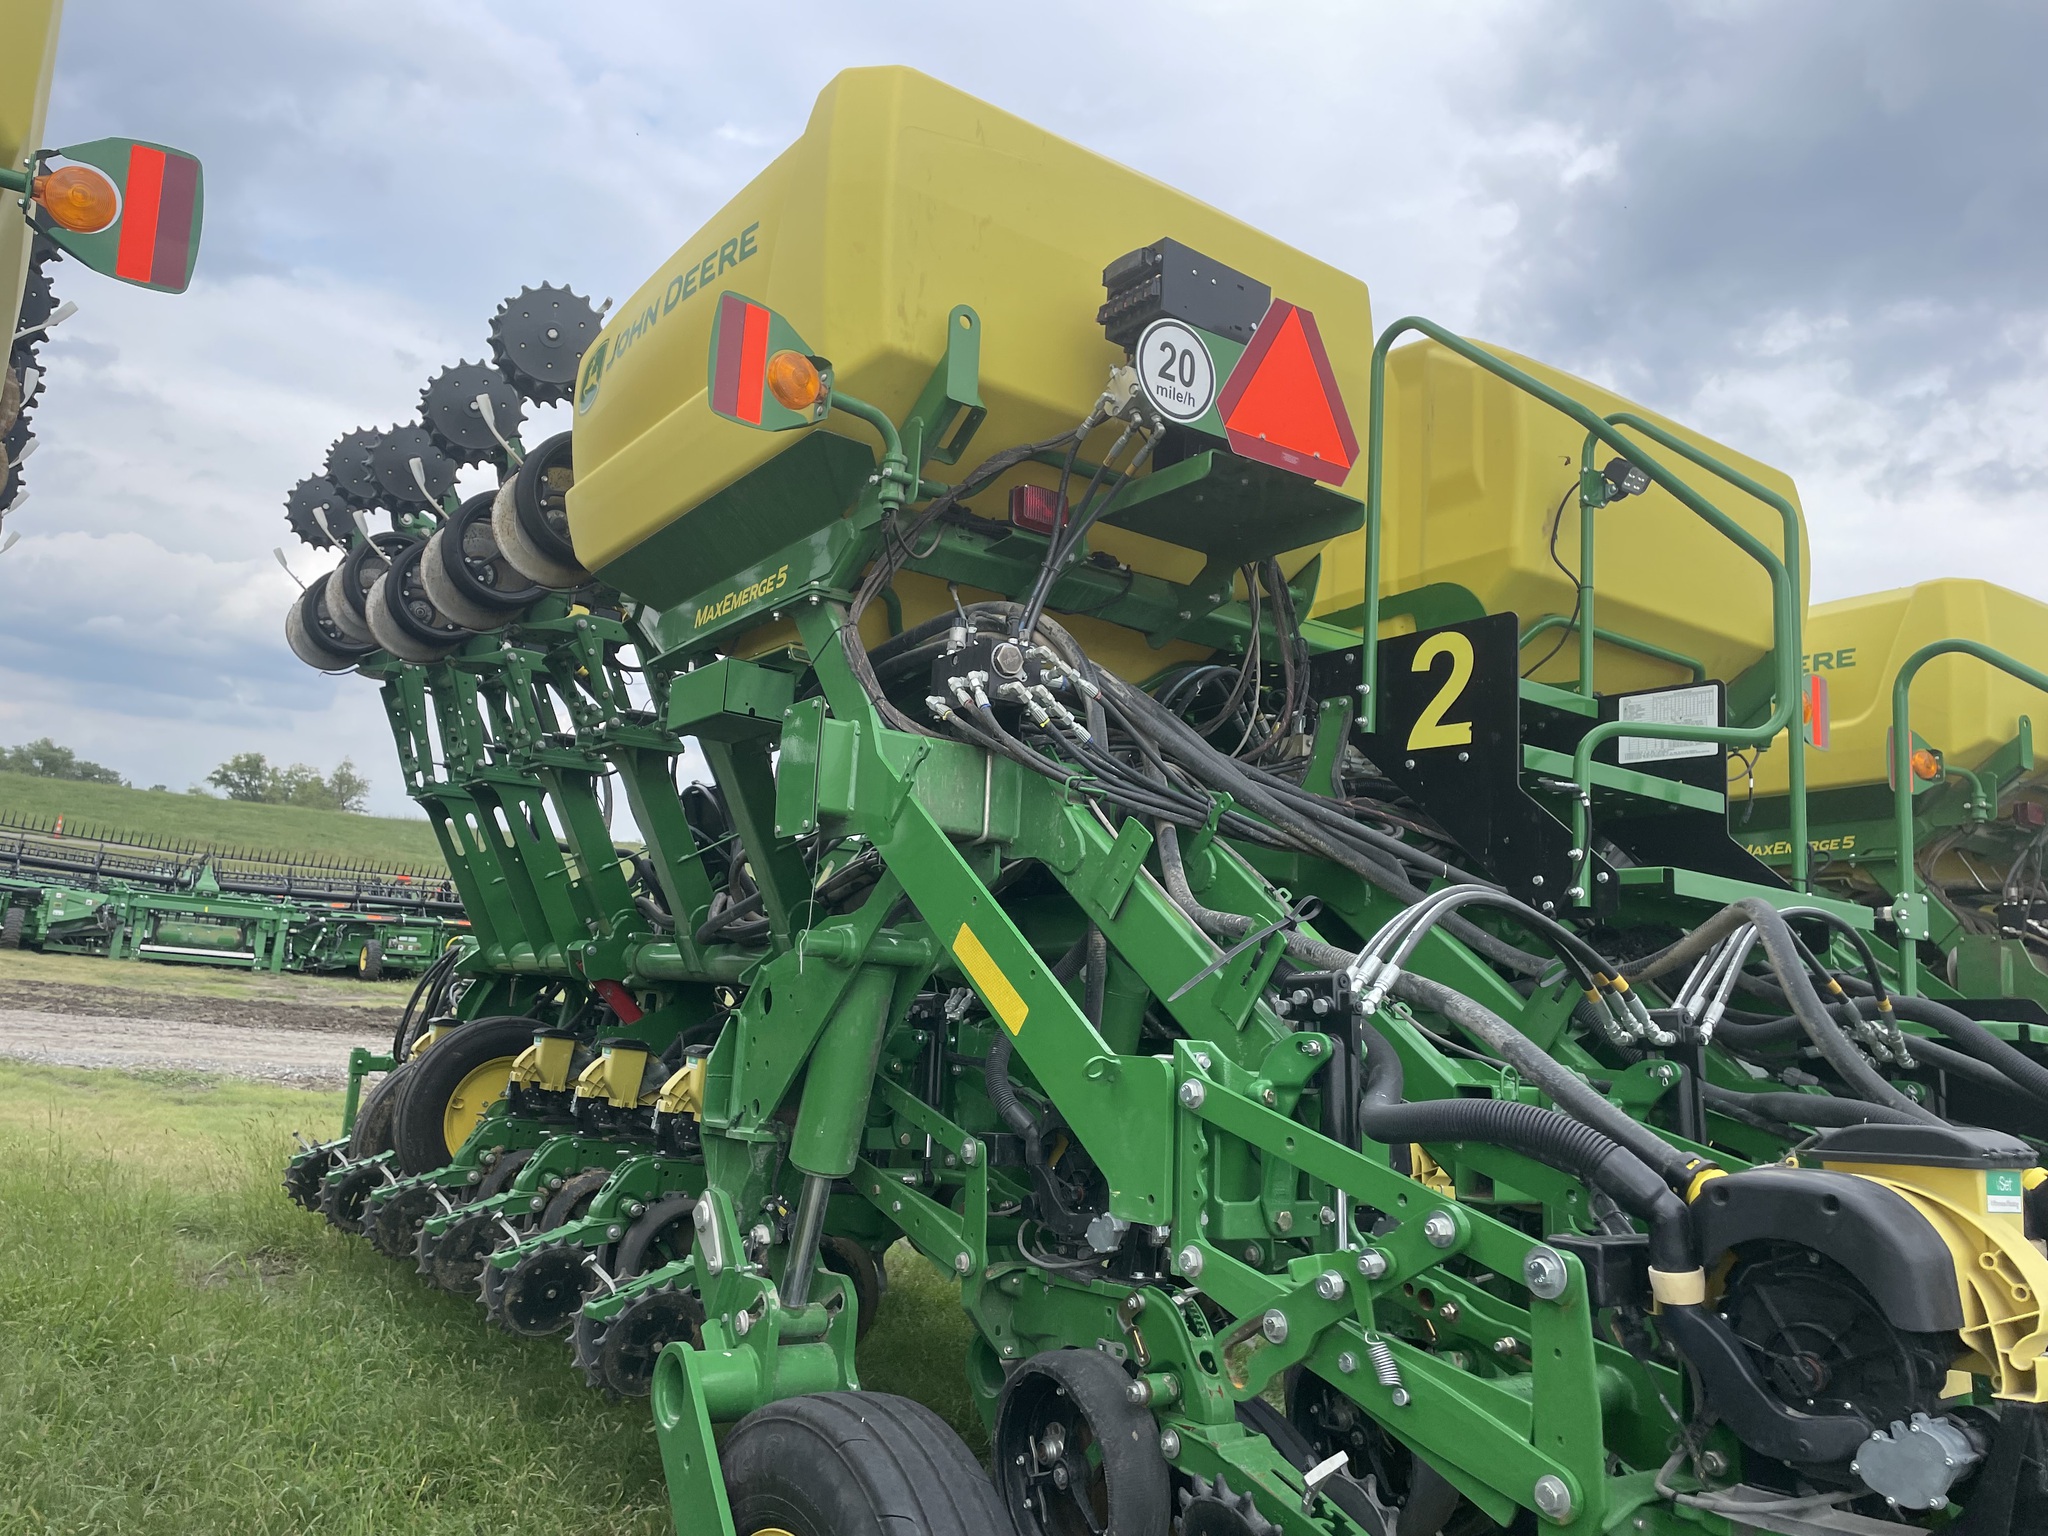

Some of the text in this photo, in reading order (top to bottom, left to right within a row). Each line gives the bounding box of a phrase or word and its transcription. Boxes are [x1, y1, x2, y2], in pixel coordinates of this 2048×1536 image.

[606, 221, 760, 372] JOHN DEERE
[1156, 384, 1196, 408] mile/h
[1158, 341, 1196, 388] 20
[1406, 631, 1475, 751] 2
